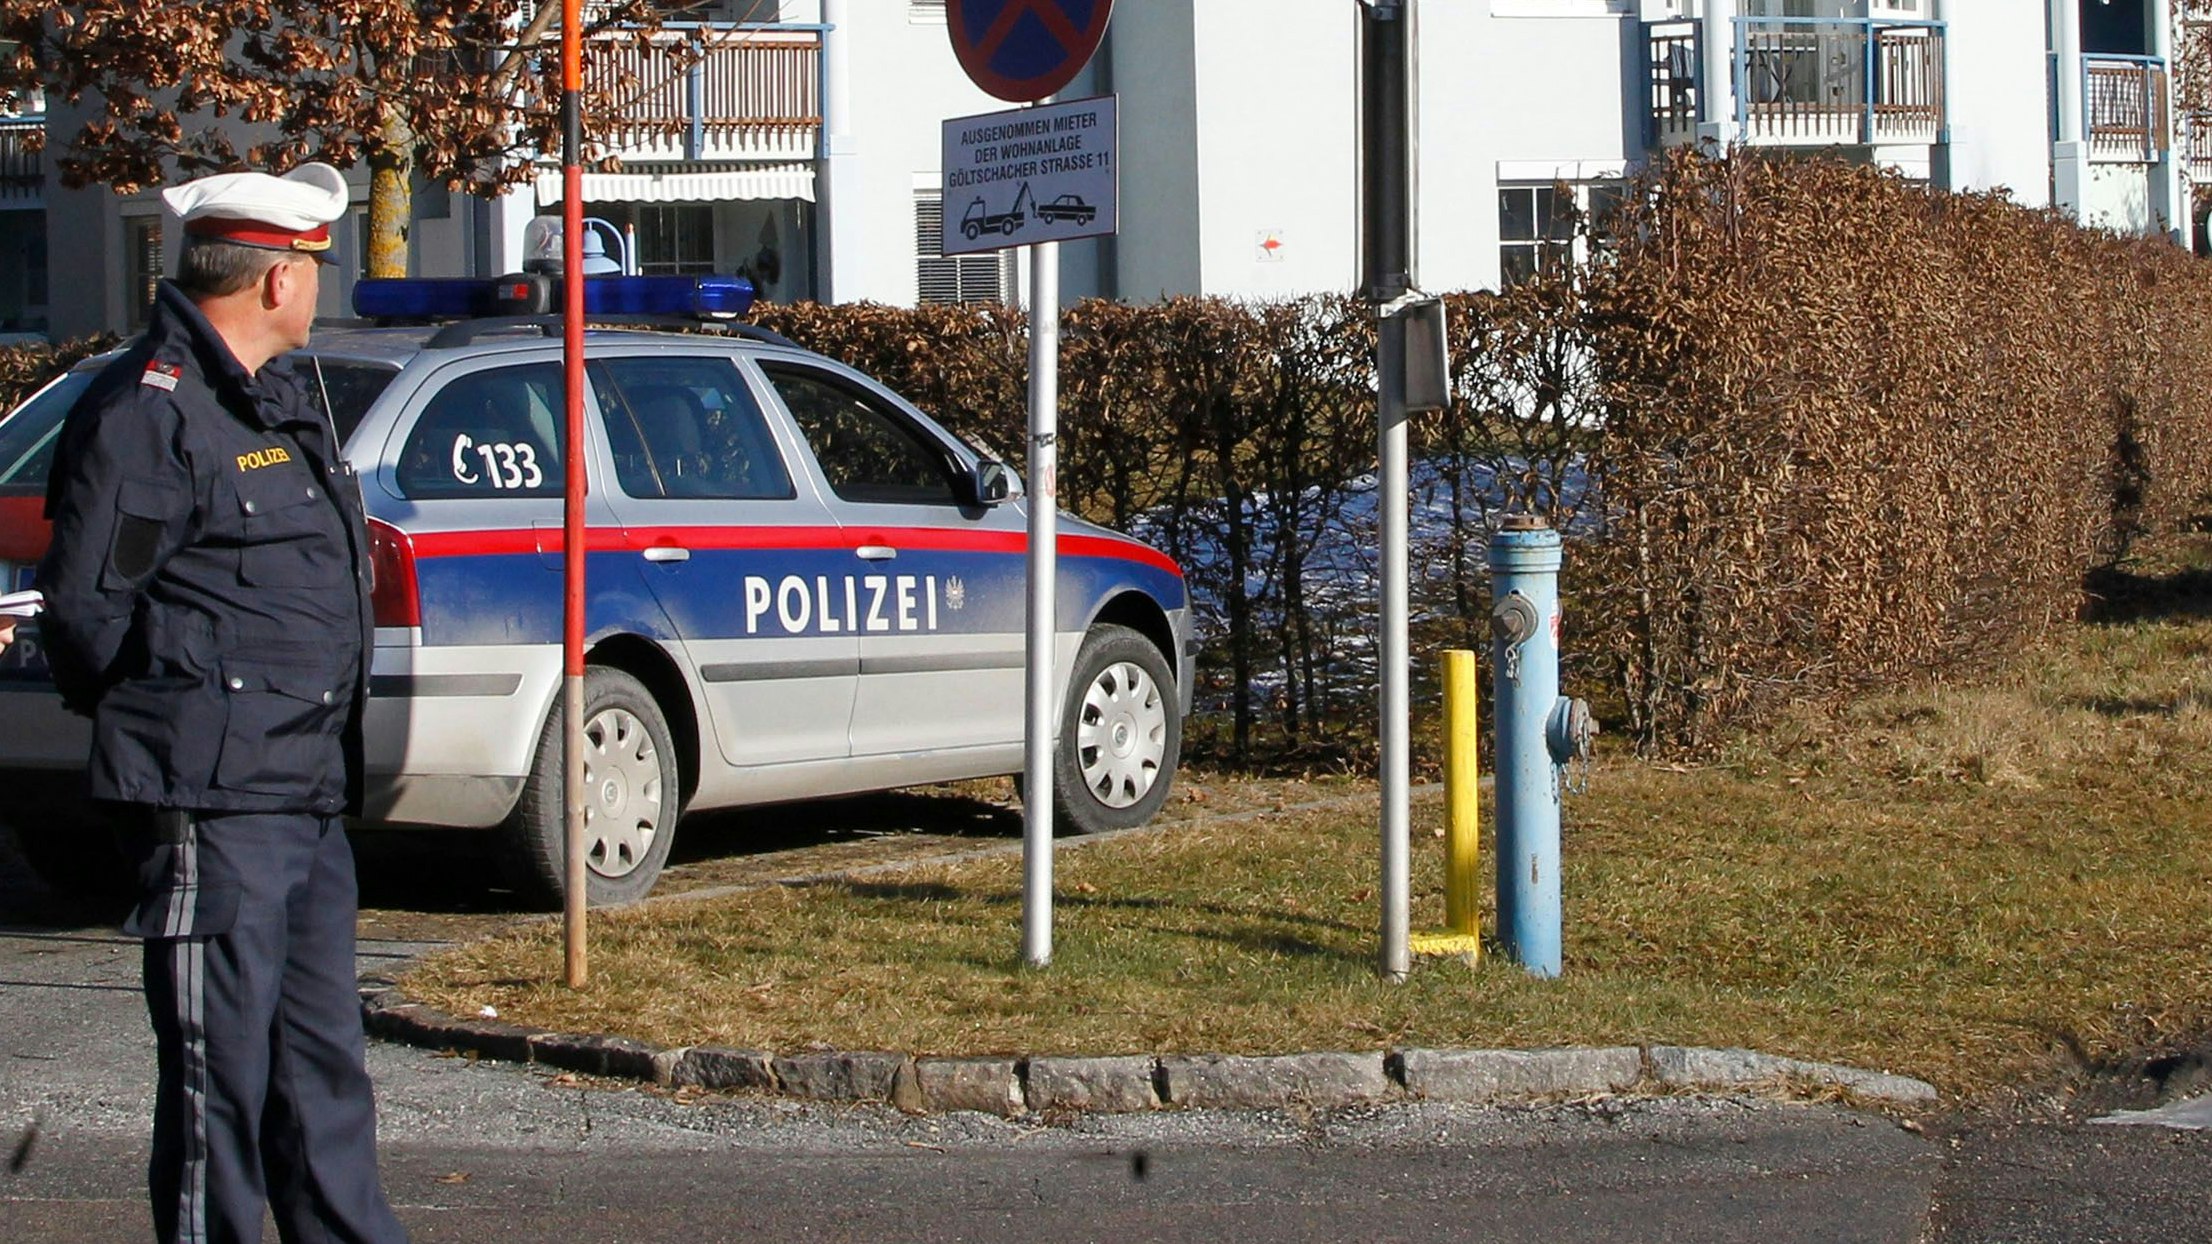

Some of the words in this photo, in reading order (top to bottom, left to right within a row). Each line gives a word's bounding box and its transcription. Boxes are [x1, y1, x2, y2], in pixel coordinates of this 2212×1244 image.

[961, 120, 1050, 146] AUSGENOMMEN
[1053, 112, 1097, 132] MIETER
[975, 146, 997, 164] DER
[1001, 135, 1082, 160] WOHNANLAGE
[949, 160, 1037, 188] GÖLTSCHACHER
[1040, 153, 1093, 174] STRASSE
[1097, 151, 1110, 167] 11
[236, 447, 291, 472] POLIZEI
[477, 442, 543, 488] 133
[744, 575, 938, 634] POLIZEI
